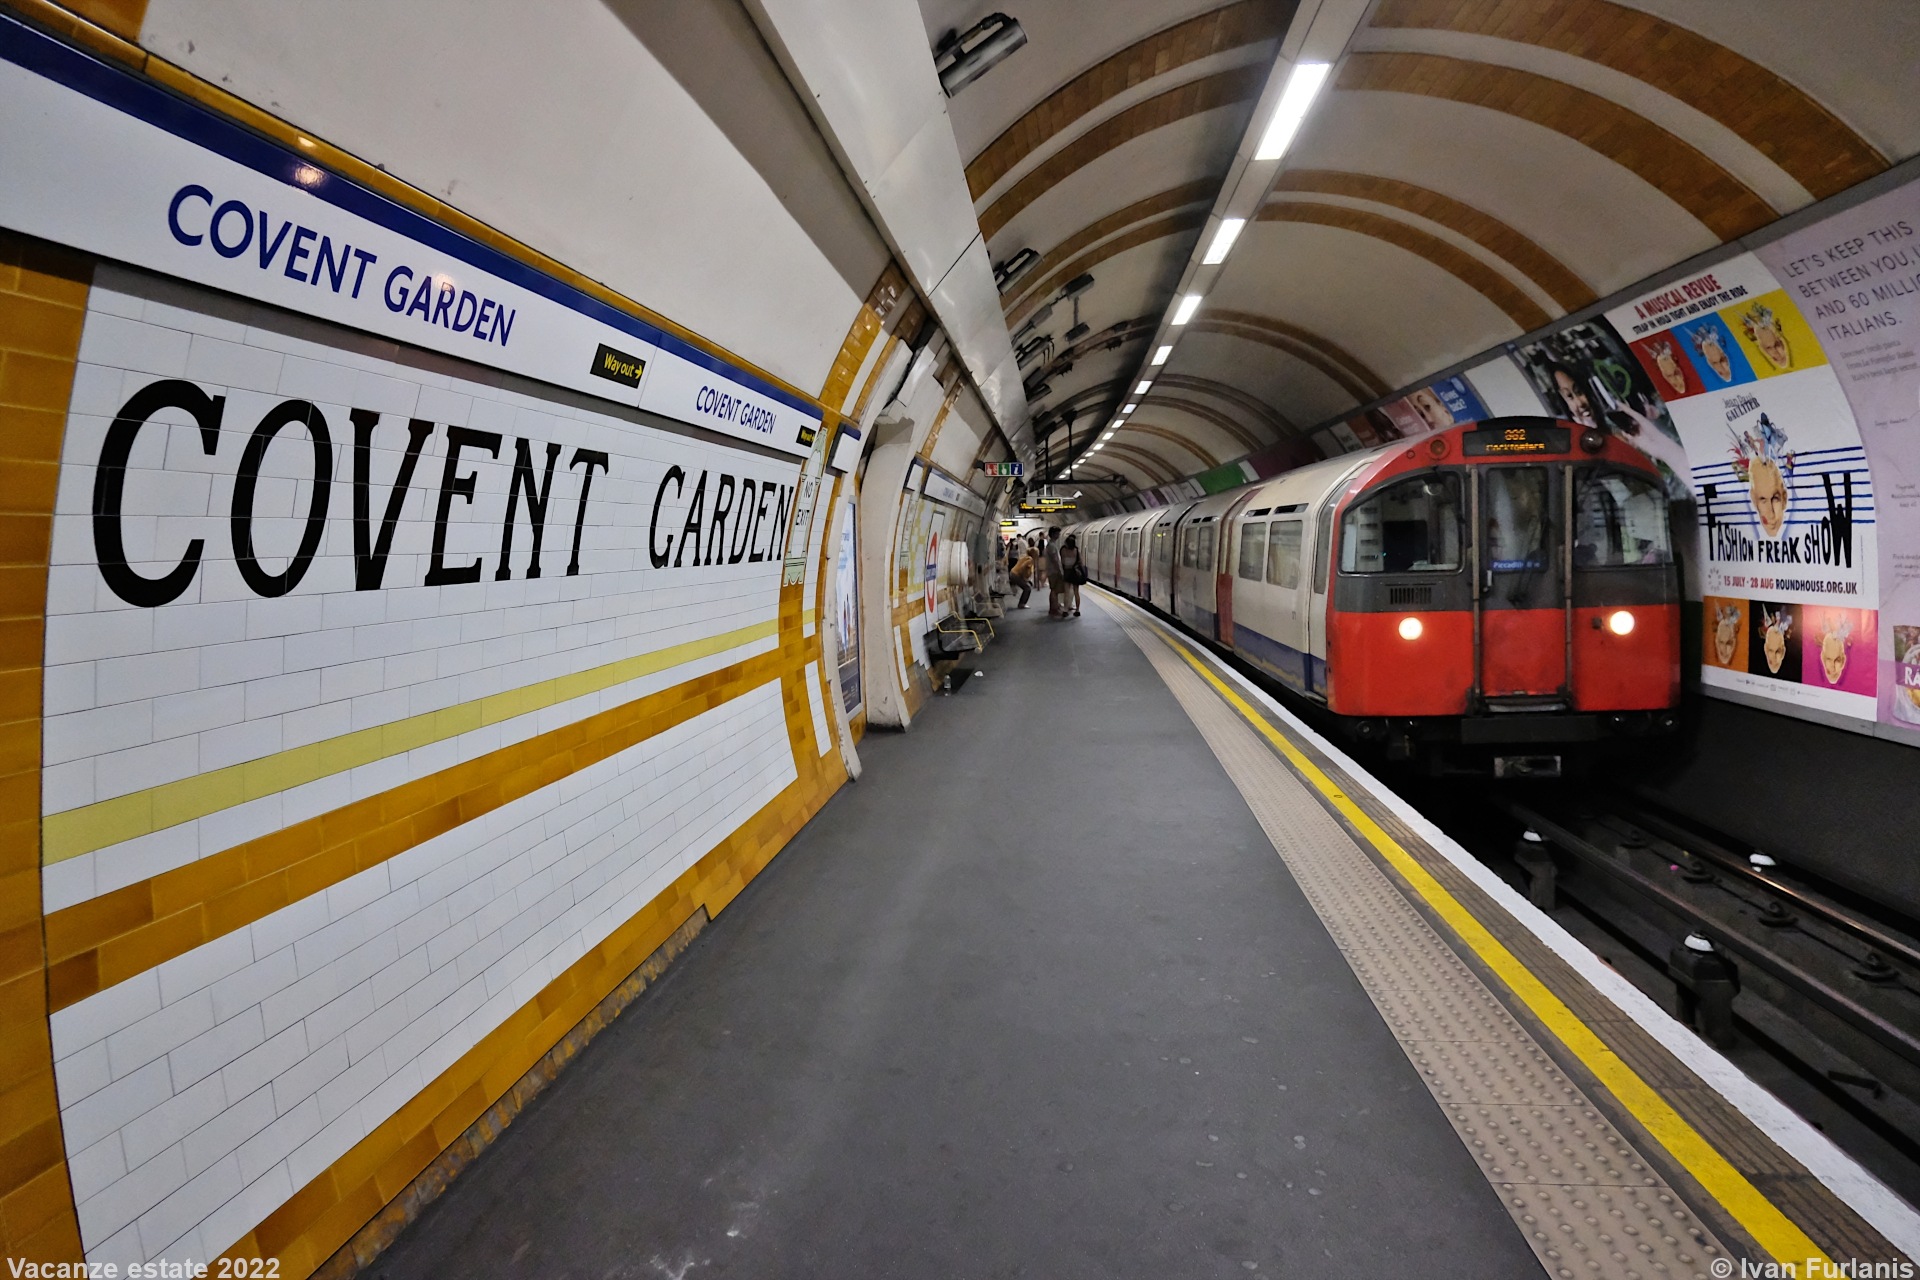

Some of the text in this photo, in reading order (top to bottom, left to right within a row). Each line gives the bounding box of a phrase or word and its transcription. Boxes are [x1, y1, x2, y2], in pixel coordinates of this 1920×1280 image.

[168, 184, 516, 347] COVENT GARDEN
[1782, 221, 1913, 278] LET'S KEEP THIS
[1634, 274, 1722, 320] A MUSICAL REVUE
[1798, 264, 1871, 298] BETWEEN
[1870, 251, 1915, 273] YOU,
[1632, 285, 1748, 335] STRAP IN HOLD TIGHT AND ENJOY THE RIDE
[1816, 299, 1846, 319] AND
[1848, 292, 1869, 309] 60
[1826, 311, 1902, 341] ITALIANS.
[604, 352, 635, 377] Way out
[696, 386, 776, 434] COVENT GARDEN
[1726, 397, 1760, 422] GAULTIER
[92, 379, 795, 608] COVENT GARDEN
[804, 481, 814, 499] NO
[795, 508, 810, 525] EXIT
[1703, 484, 1754, 561] FASHION
[1758, 537, 1801, 563] FREAK
[1804, 472, 1851, 568] SHOW
[1723, 576, 1731, 587] 15
[1732, 576, 1746, 588] JULY
[1750, 577, 1759, 589] 28
[1760, 578, 1774, 590] AUG
[1776, 578, 1858, 595] ROUNDHOUSE.ORG.UK
